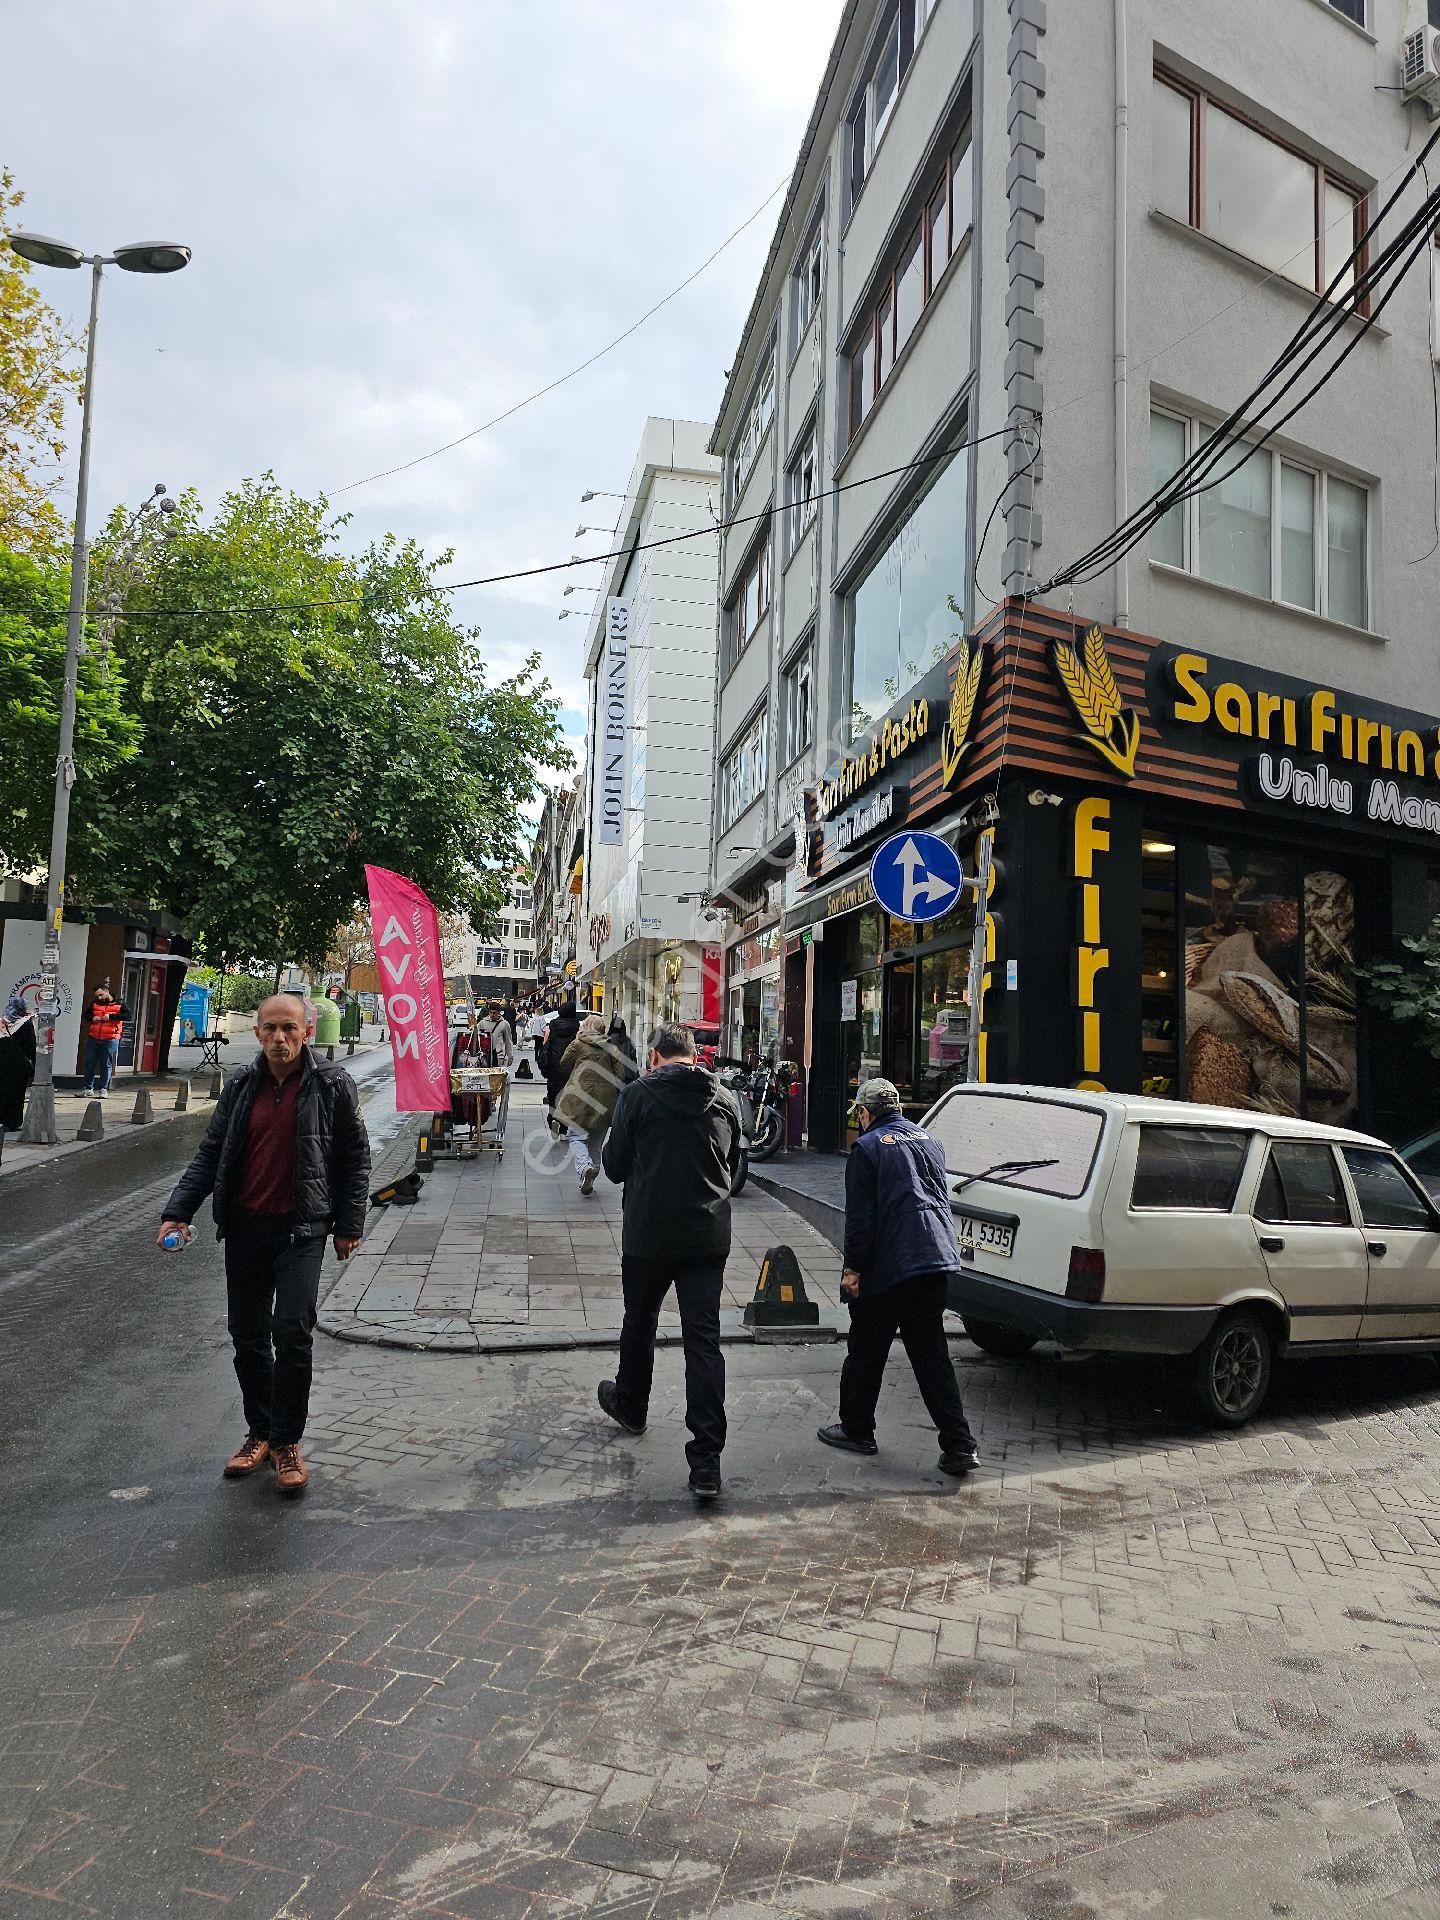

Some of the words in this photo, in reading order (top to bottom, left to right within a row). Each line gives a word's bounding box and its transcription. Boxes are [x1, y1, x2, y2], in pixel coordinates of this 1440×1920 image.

[606, 605, 628, 741] BORNERS
[1174, 653, 1297, 747] Sarı
[603, 753, 624, 835] JOHN
[815, 778, 844, 822] Sarı
[868, 734, 879, 777] &
[880, 697, 929, 769] Pasta
[1258, 752, 1353, 815] Unlu
[960, 1217, 973, 1239] YA
[979, 1223, 1012, 1248] 5335
